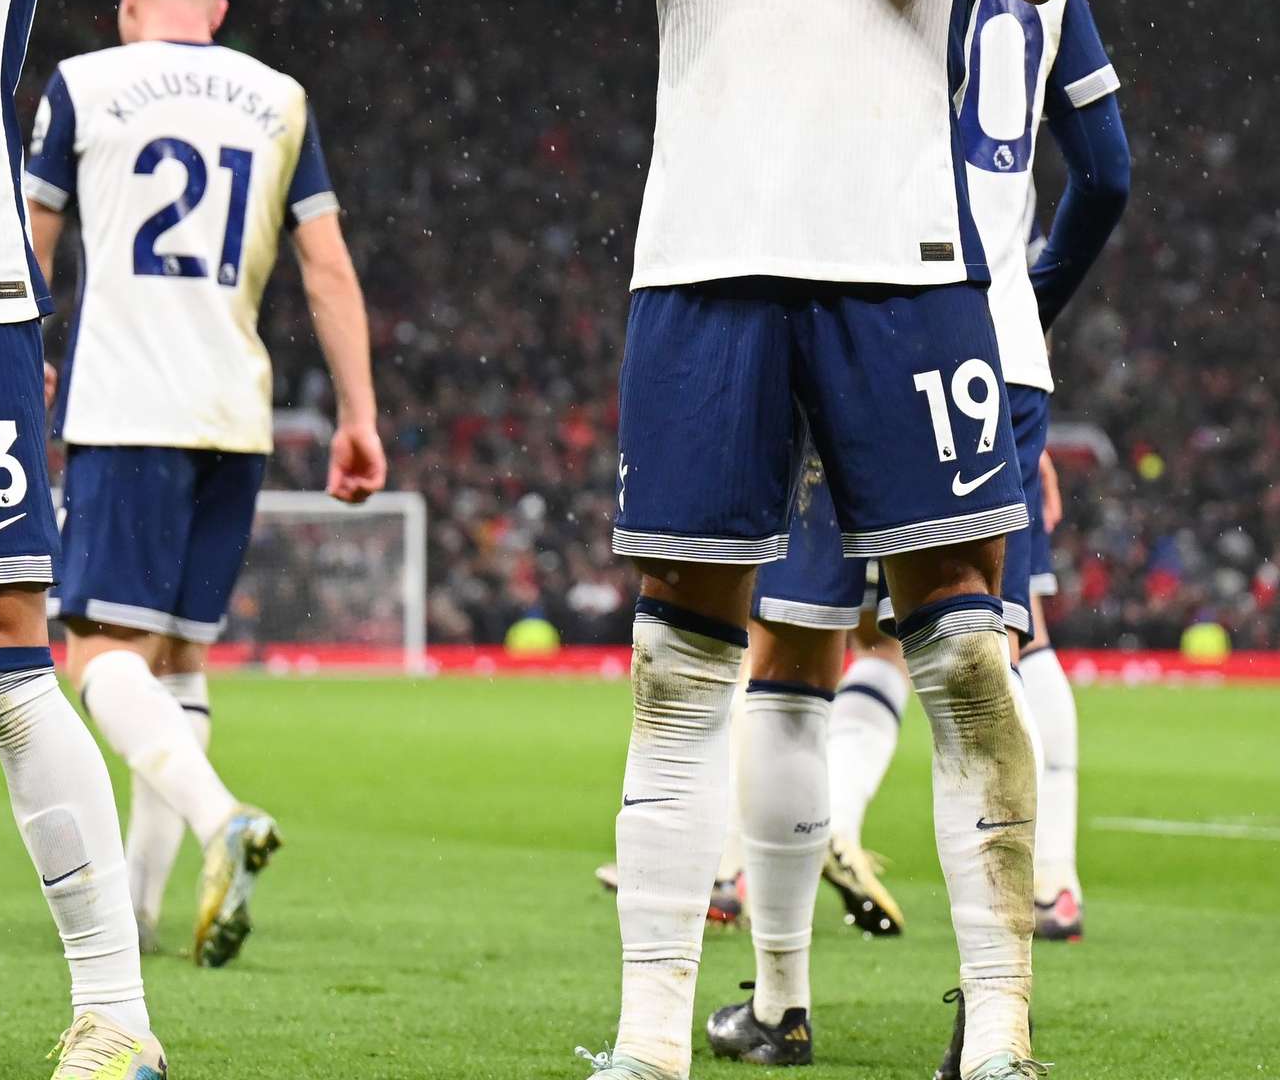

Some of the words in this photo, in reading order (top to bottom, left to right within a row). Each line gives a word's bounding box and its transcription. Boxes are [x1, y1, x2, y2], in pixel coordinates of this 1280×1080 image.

[106, 70, 288, 140] KULUSEVSKI
[133, 136, 254, 286] 21
[913, 358, 1000, 462] 19
